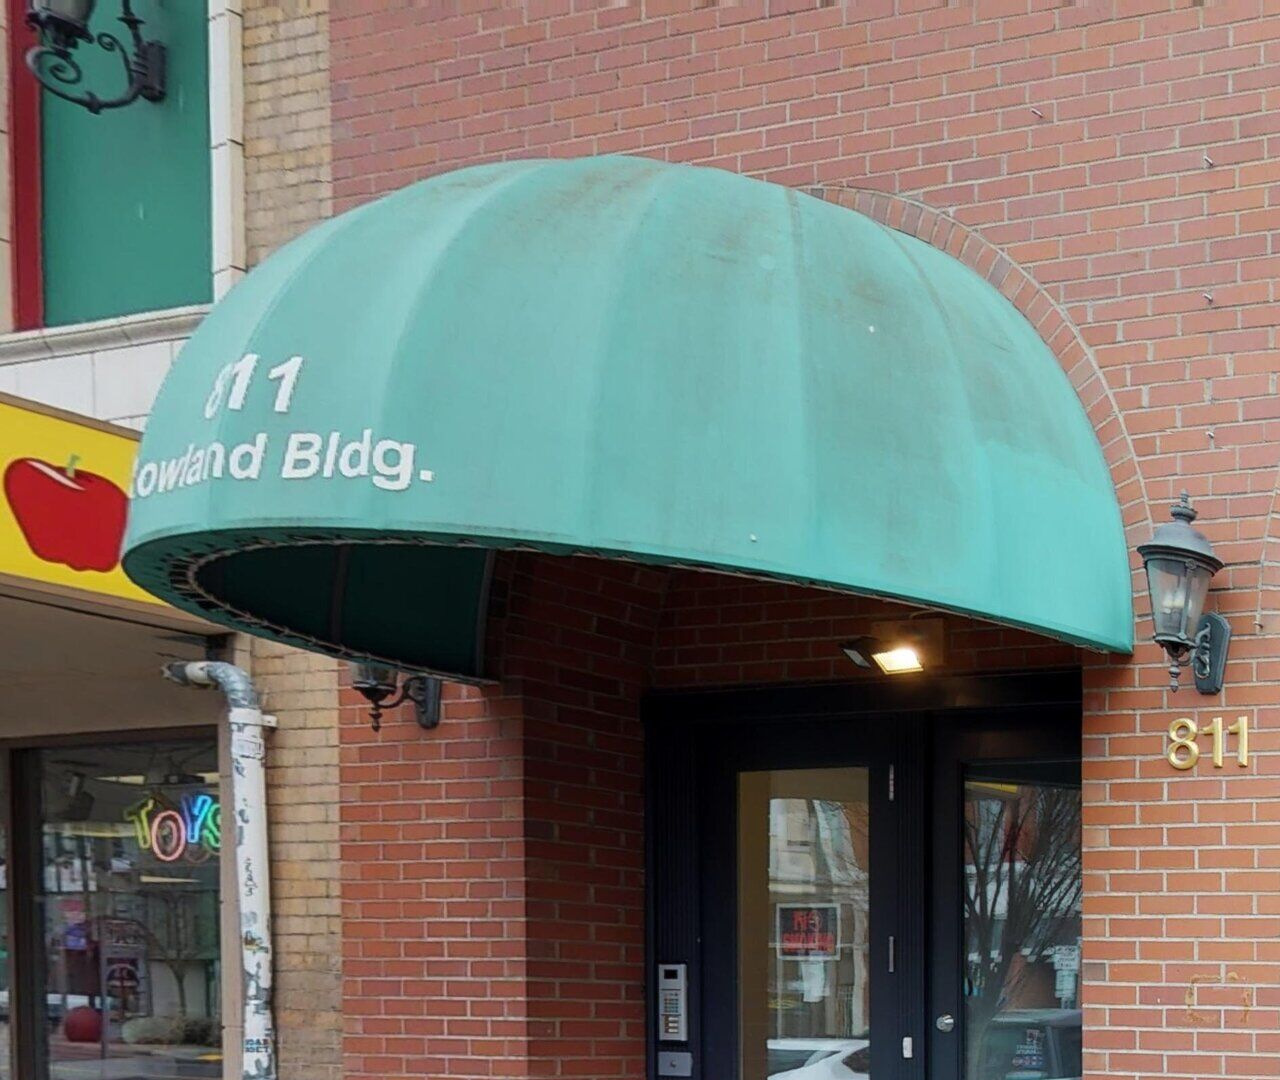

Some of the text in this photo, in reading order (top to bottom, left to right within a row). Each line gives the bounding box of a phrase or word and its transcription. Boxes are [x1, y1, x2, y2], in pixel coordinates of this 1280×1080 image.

[204, 353, 303, 420] 811
[133, 428, 434, 499] owland Bldg.
[1166, 715, 1249, 771] 811
